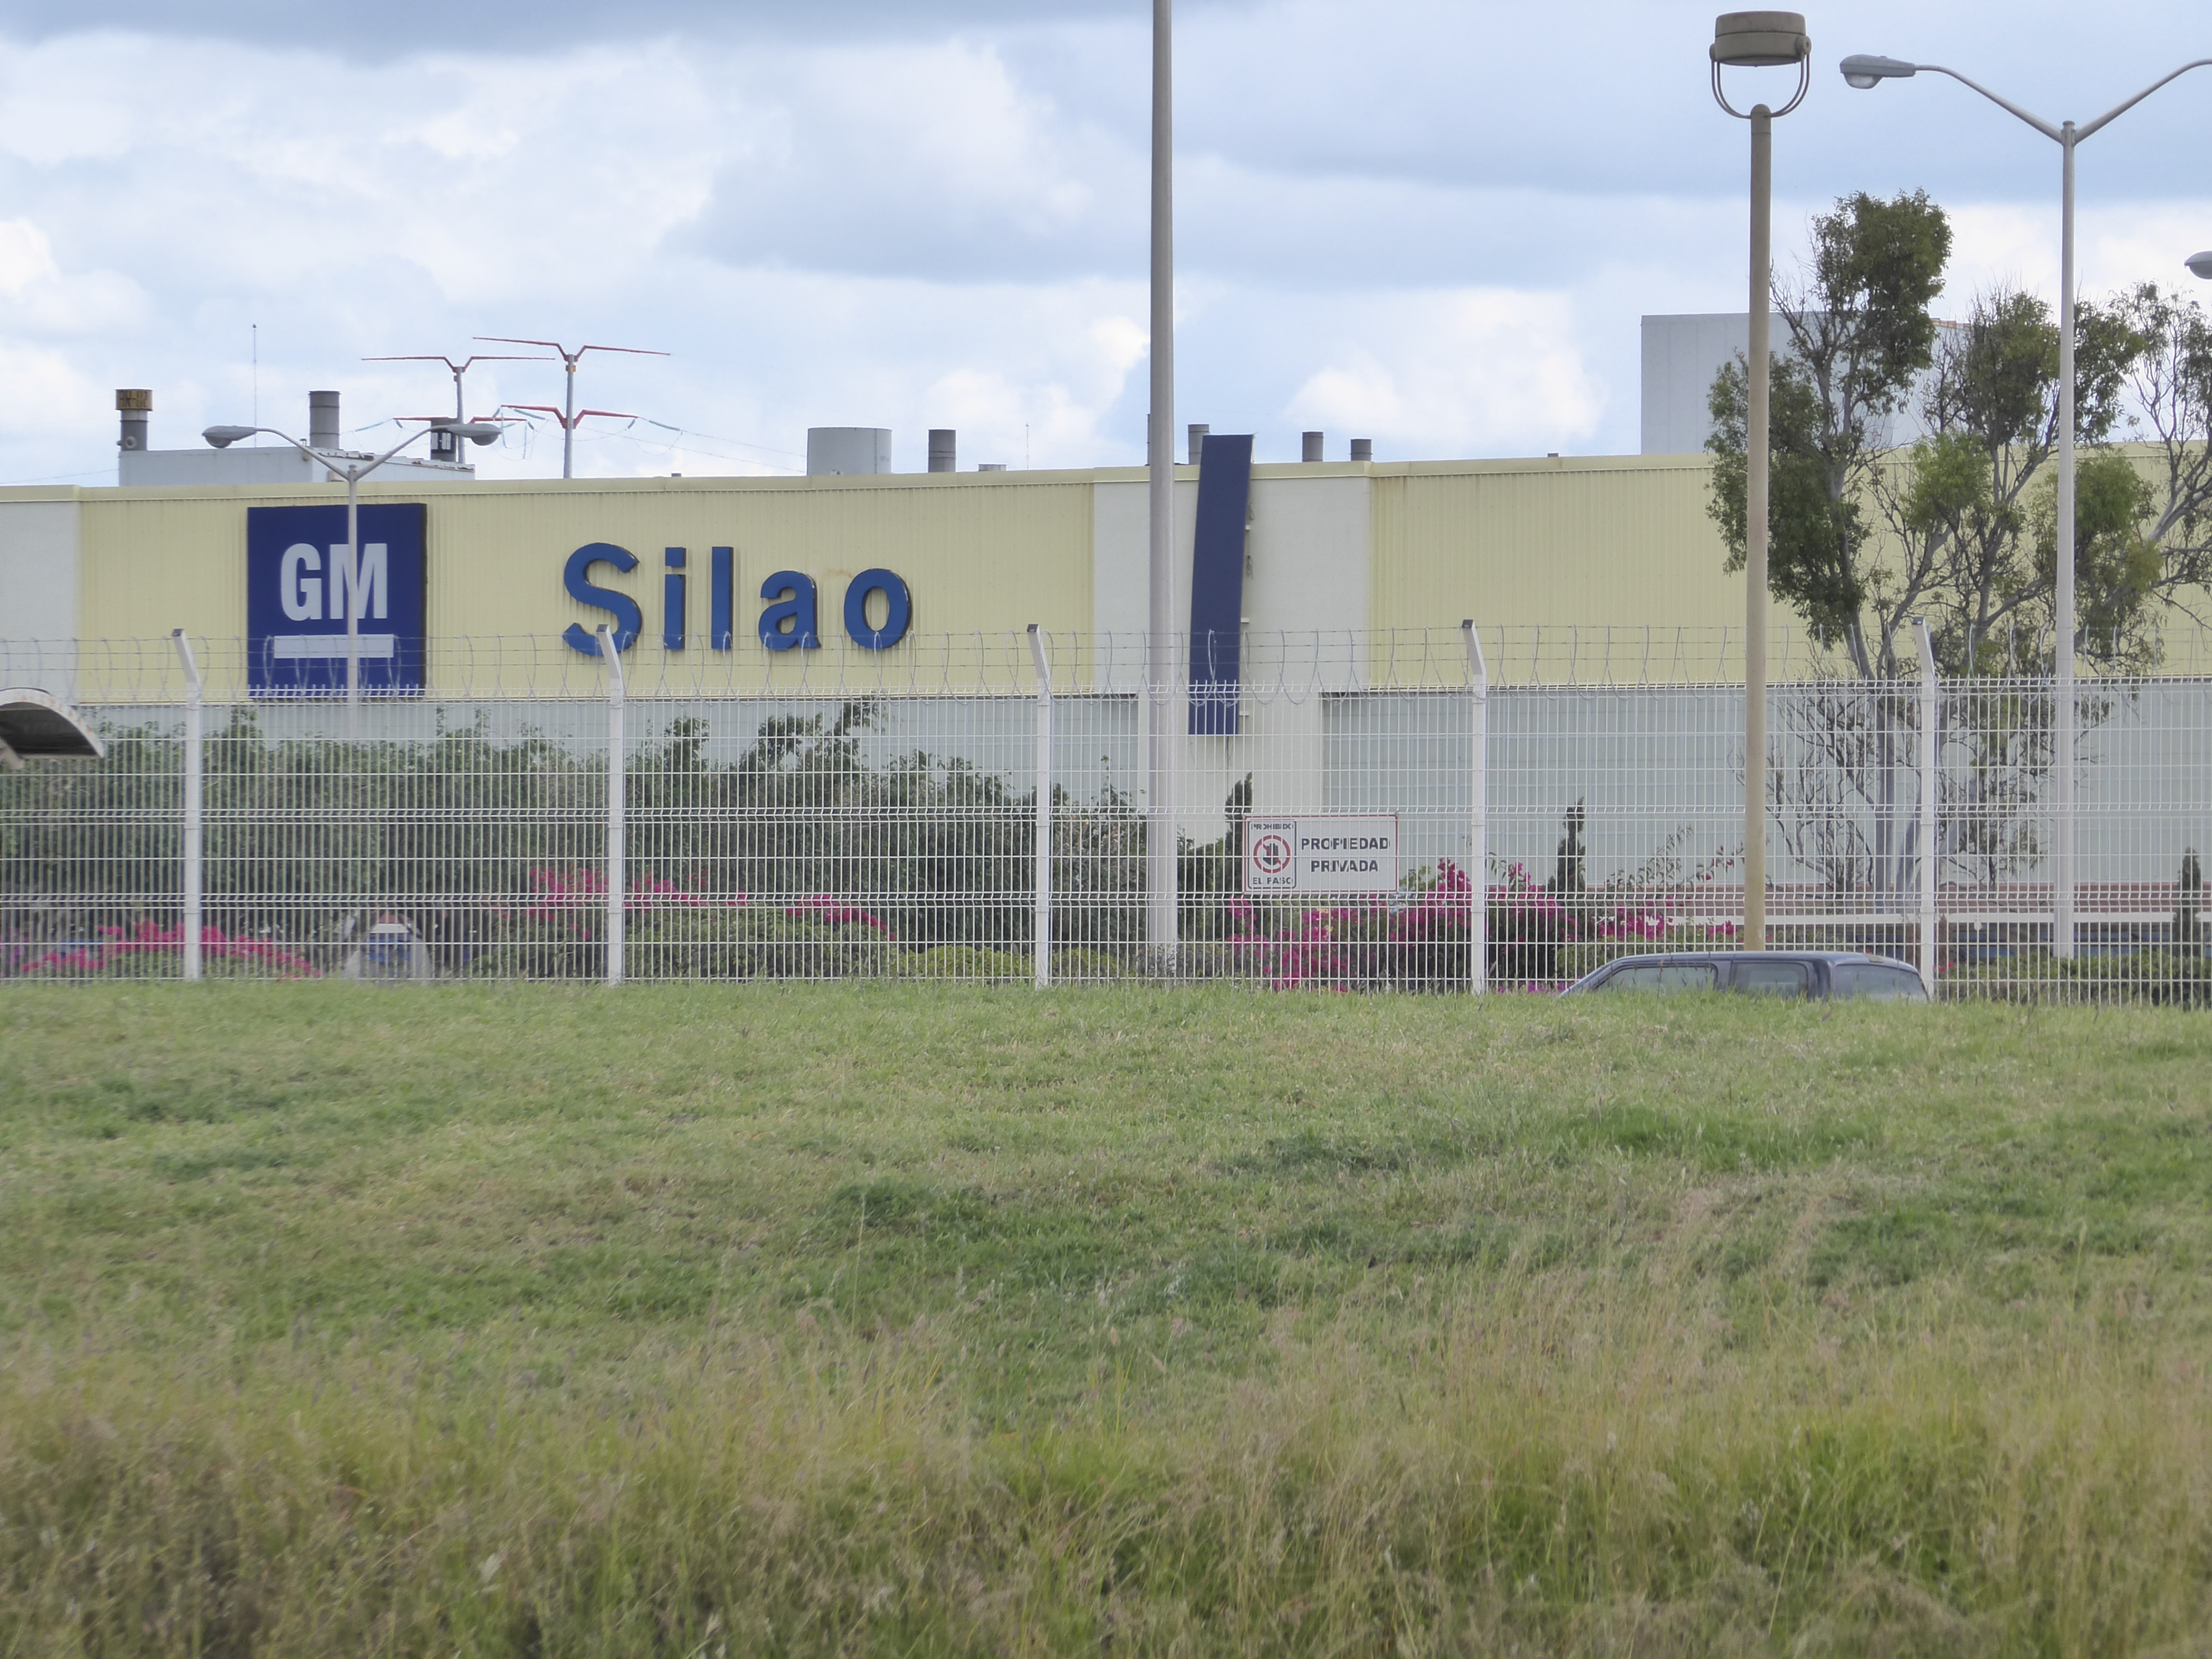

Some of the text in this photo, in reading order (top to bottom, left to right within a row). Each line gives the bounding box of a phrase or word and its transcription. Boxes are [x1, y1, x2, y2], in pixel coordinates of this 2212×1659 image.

[280, 542, 388, 622] GM
[561, 542, 913, 657] Silao
[1301, 837, 1391, 851] PROPIEDAD
[1311, 859, 1379, 873] PRIVADA
